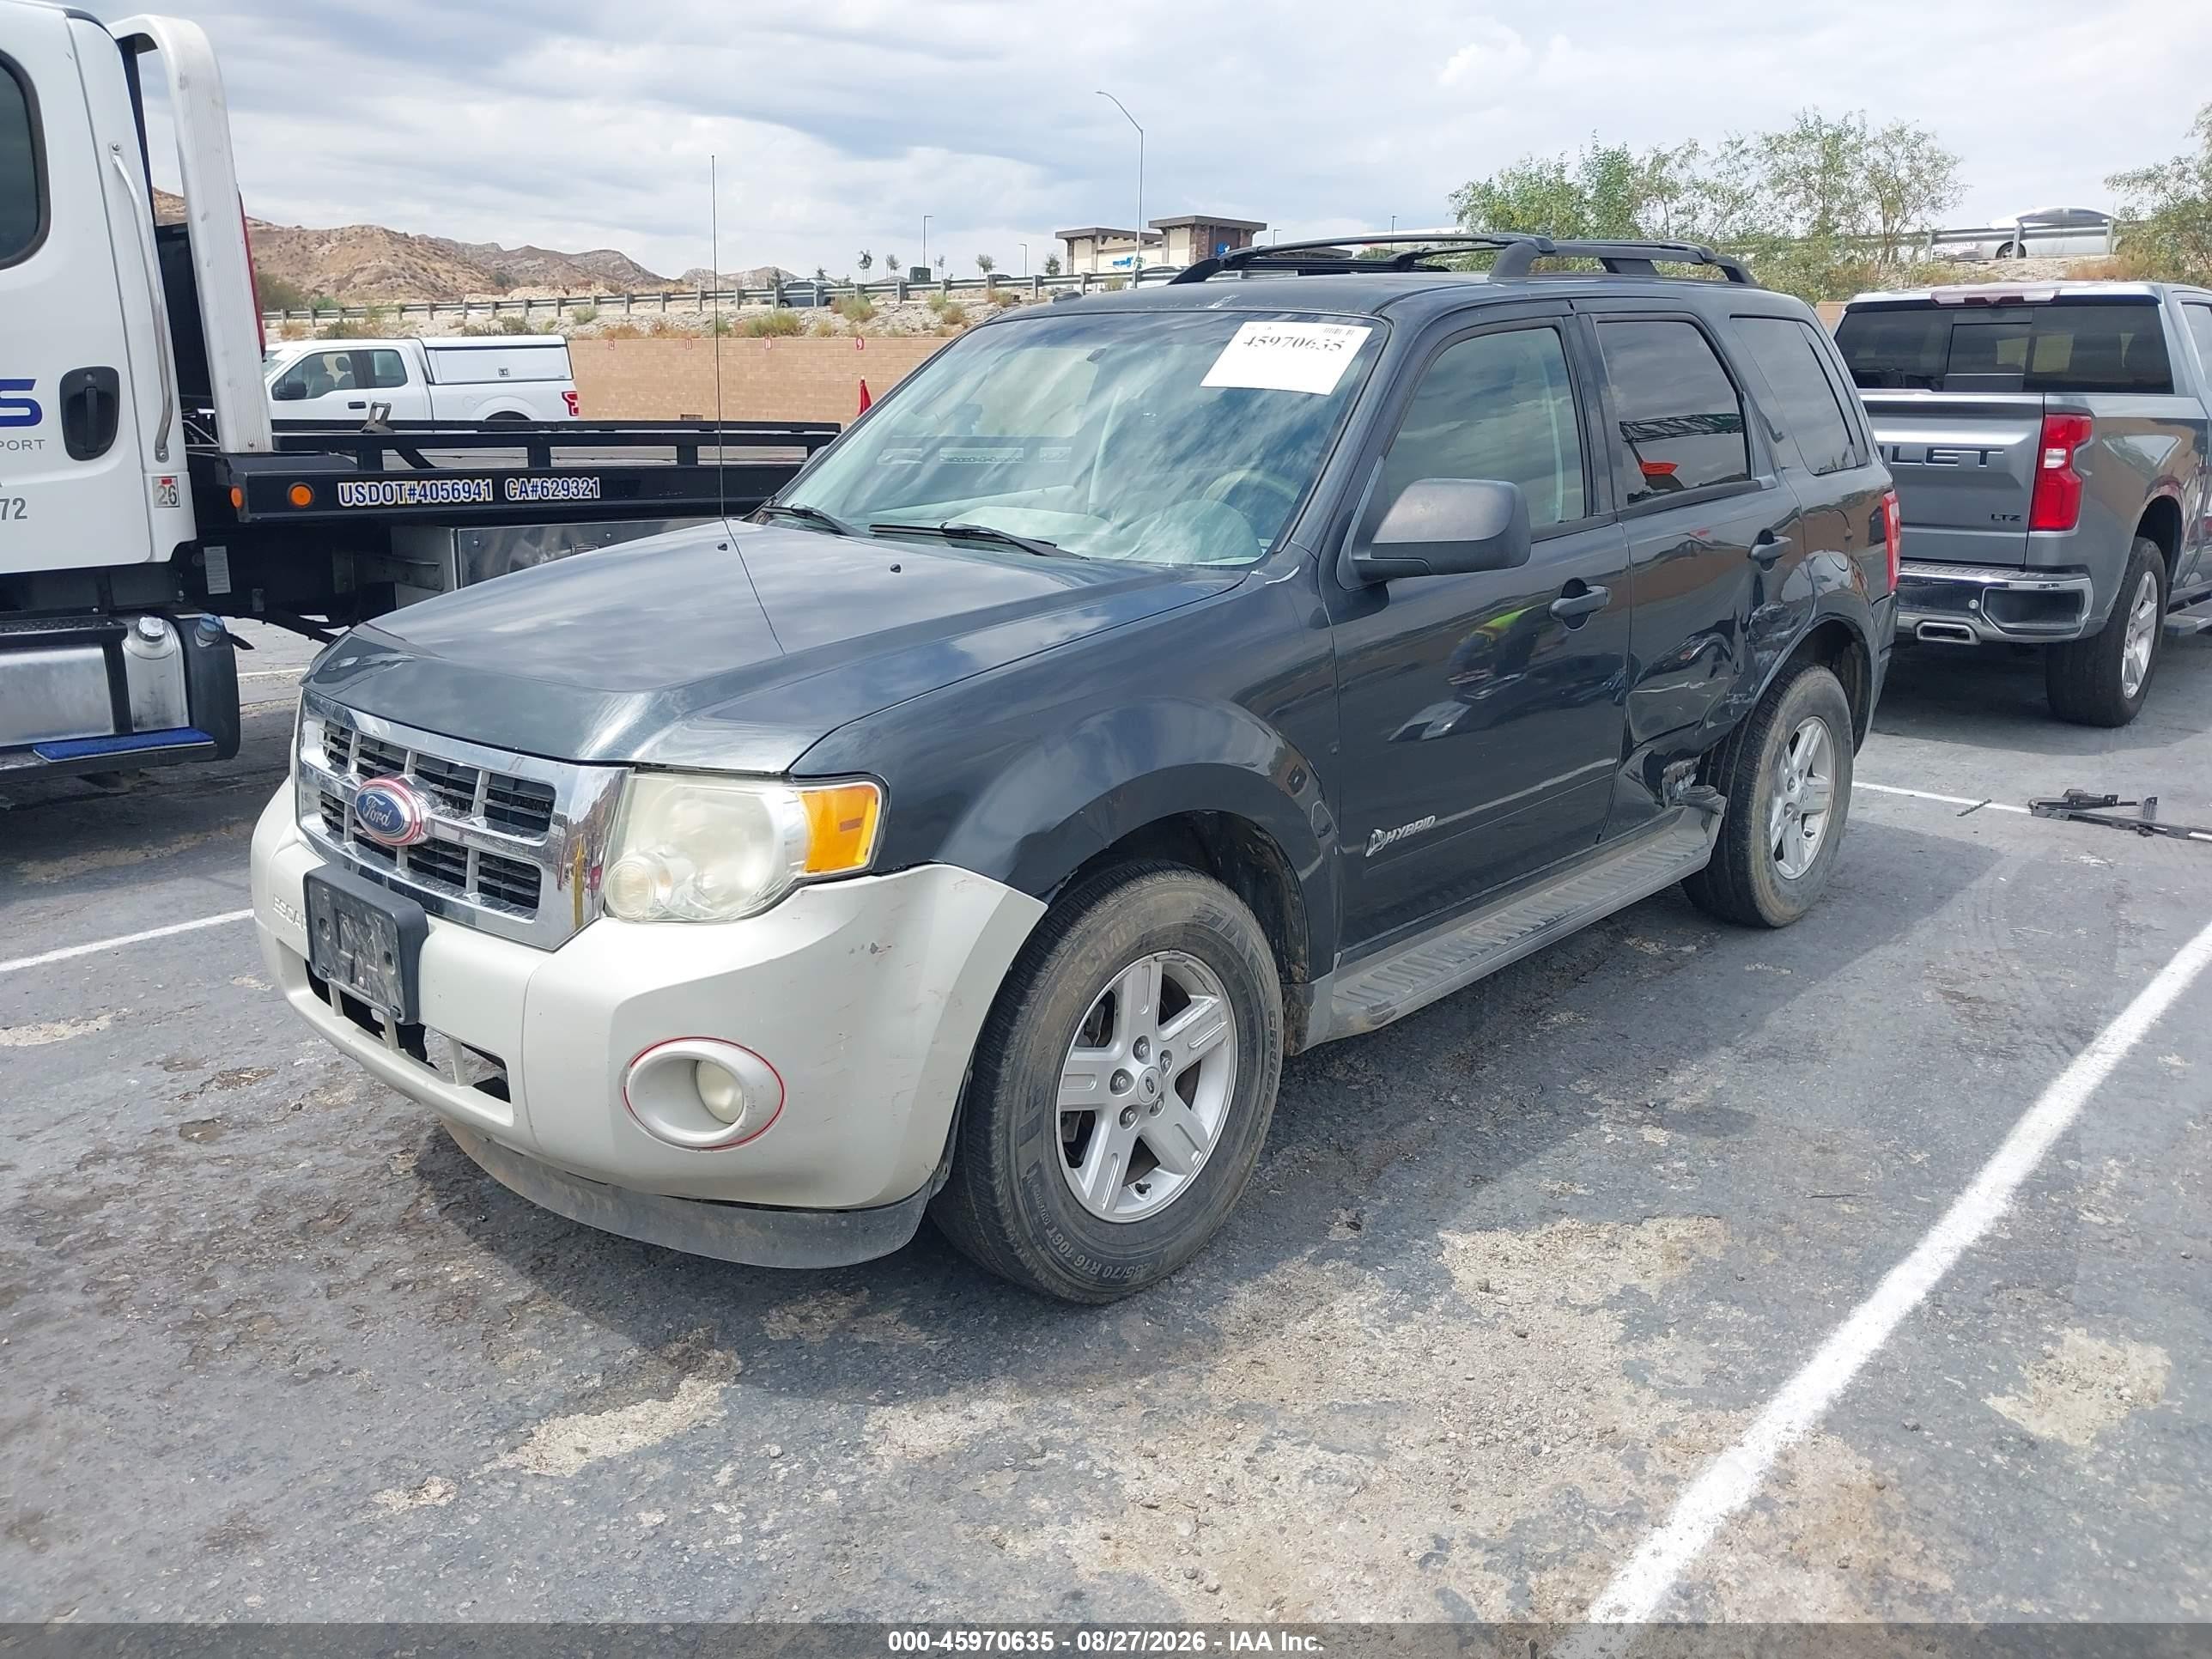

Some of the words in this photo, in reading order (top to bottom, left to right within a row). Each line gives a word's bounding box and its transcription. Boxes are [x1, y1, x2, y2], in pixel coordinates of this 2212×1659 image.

[1879, 445, 2004, 468] LET
[157, 484, 178, 505] 26
[337, 479, 494, 507] USDOT#4056941
[505, 477, 601, 500] CA#629321
[1990, 514, 2022, 522] LTZ
[362, 795, 392, 827] Ford
[1385, 815, 1436, 843] HYBRID
[1045, 1226, 1073, 1259] 106T
[1074, 1255, 1102, 1276] R16
